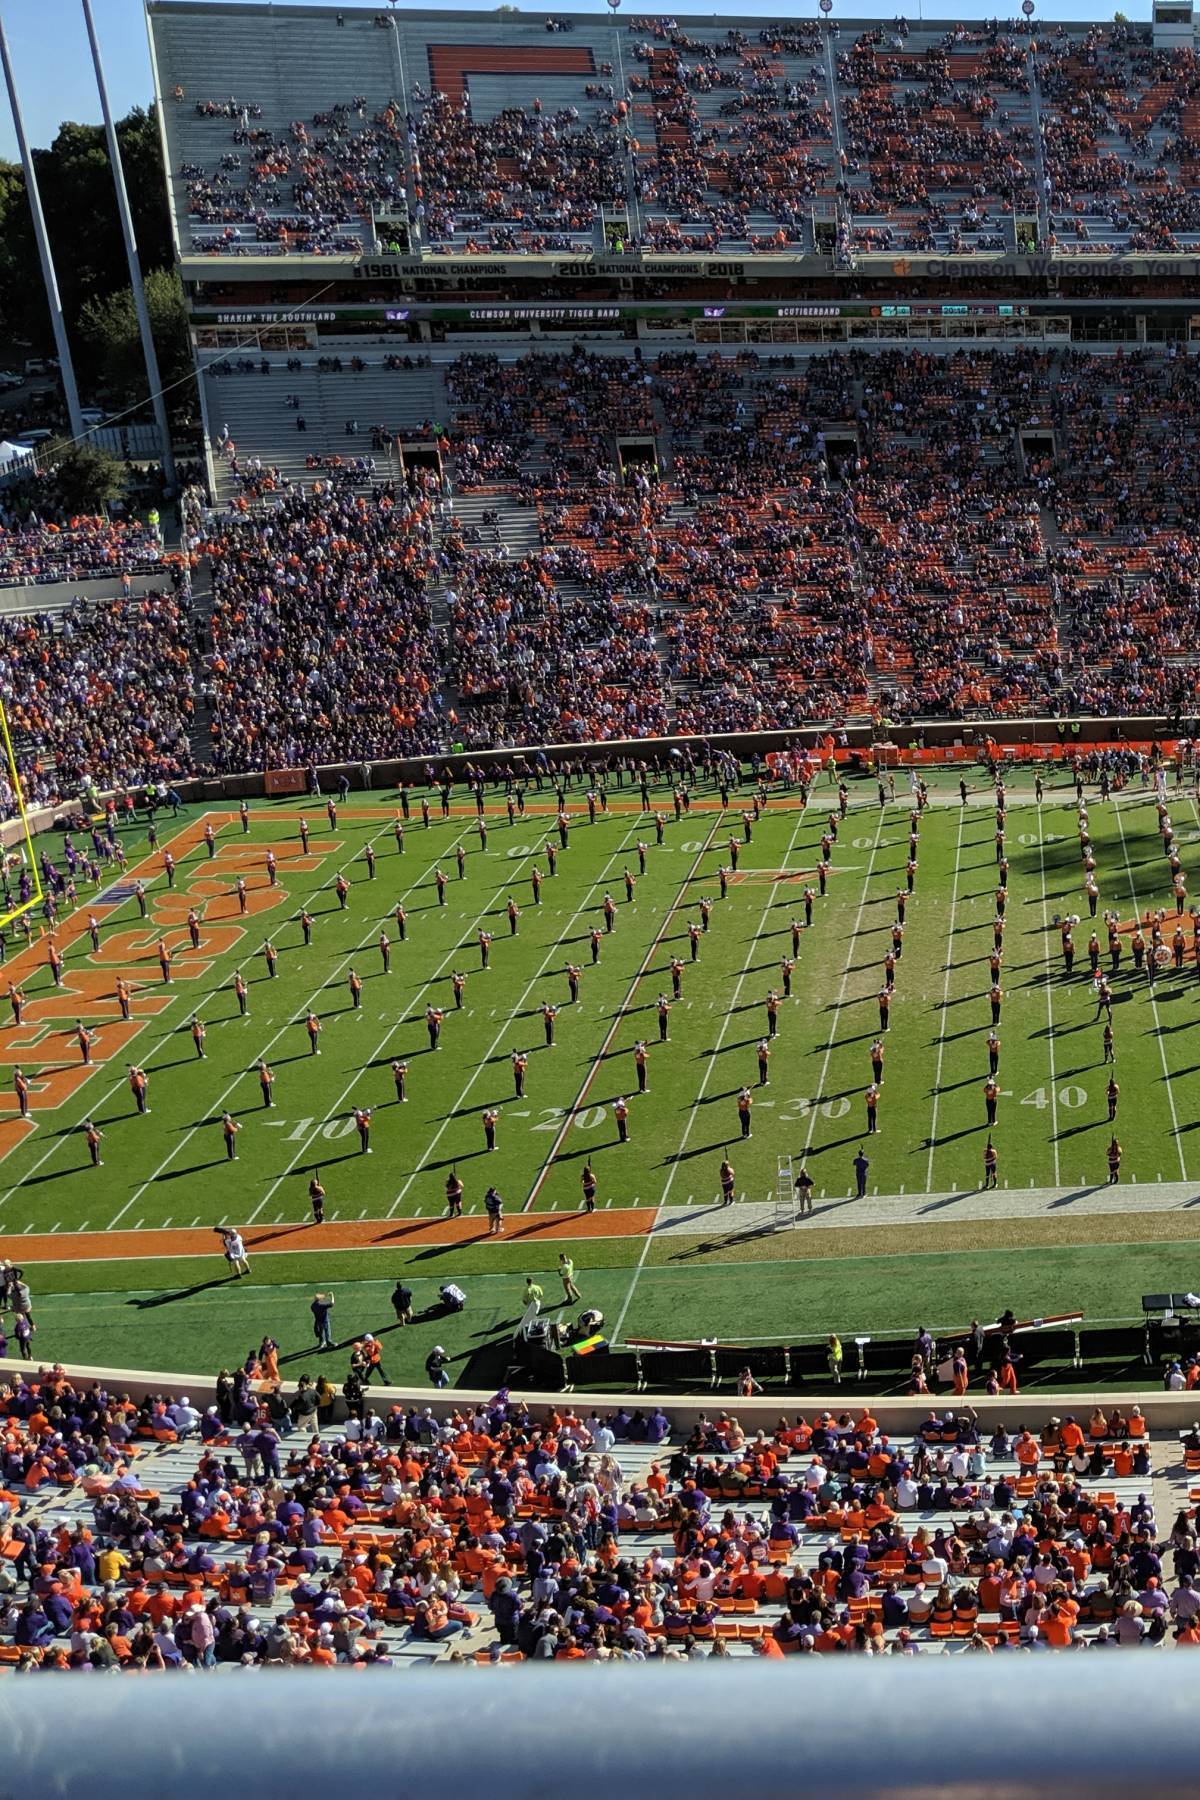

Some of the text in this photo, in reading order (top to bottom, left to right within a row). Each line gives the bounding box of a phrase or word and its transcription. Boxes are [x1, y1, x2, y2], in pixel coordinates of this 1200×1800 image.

[363, 264, 507, 277] 1981 NATIONAL CHAMPIONS
[559, 263, 699, 276] 2016 NATIONAL CHAMPIONS
[708, 263, 745, 276] 2018
[926, 259, 1016, 276] Clemson
[1027, 259, 1134, 276] Welcomes
[1144, 259, 1181, 276] You
[217, 313, 336, 323] SHAKIN' THE SOUTHLAND
[470, 309, 620, 319] CLEMSON UNIVERSITY TIGER BAND
[777, 308, 841, 317] @CUTIGERBAND
[1020, 1086, 1089, 1110] 40
[778, 1097, 852, 1121] 30
[528, 1105, 607, 1131] 20
[280, 1116, 357, 1141] 10
[1086, 1520, 1093, 1530] 6
